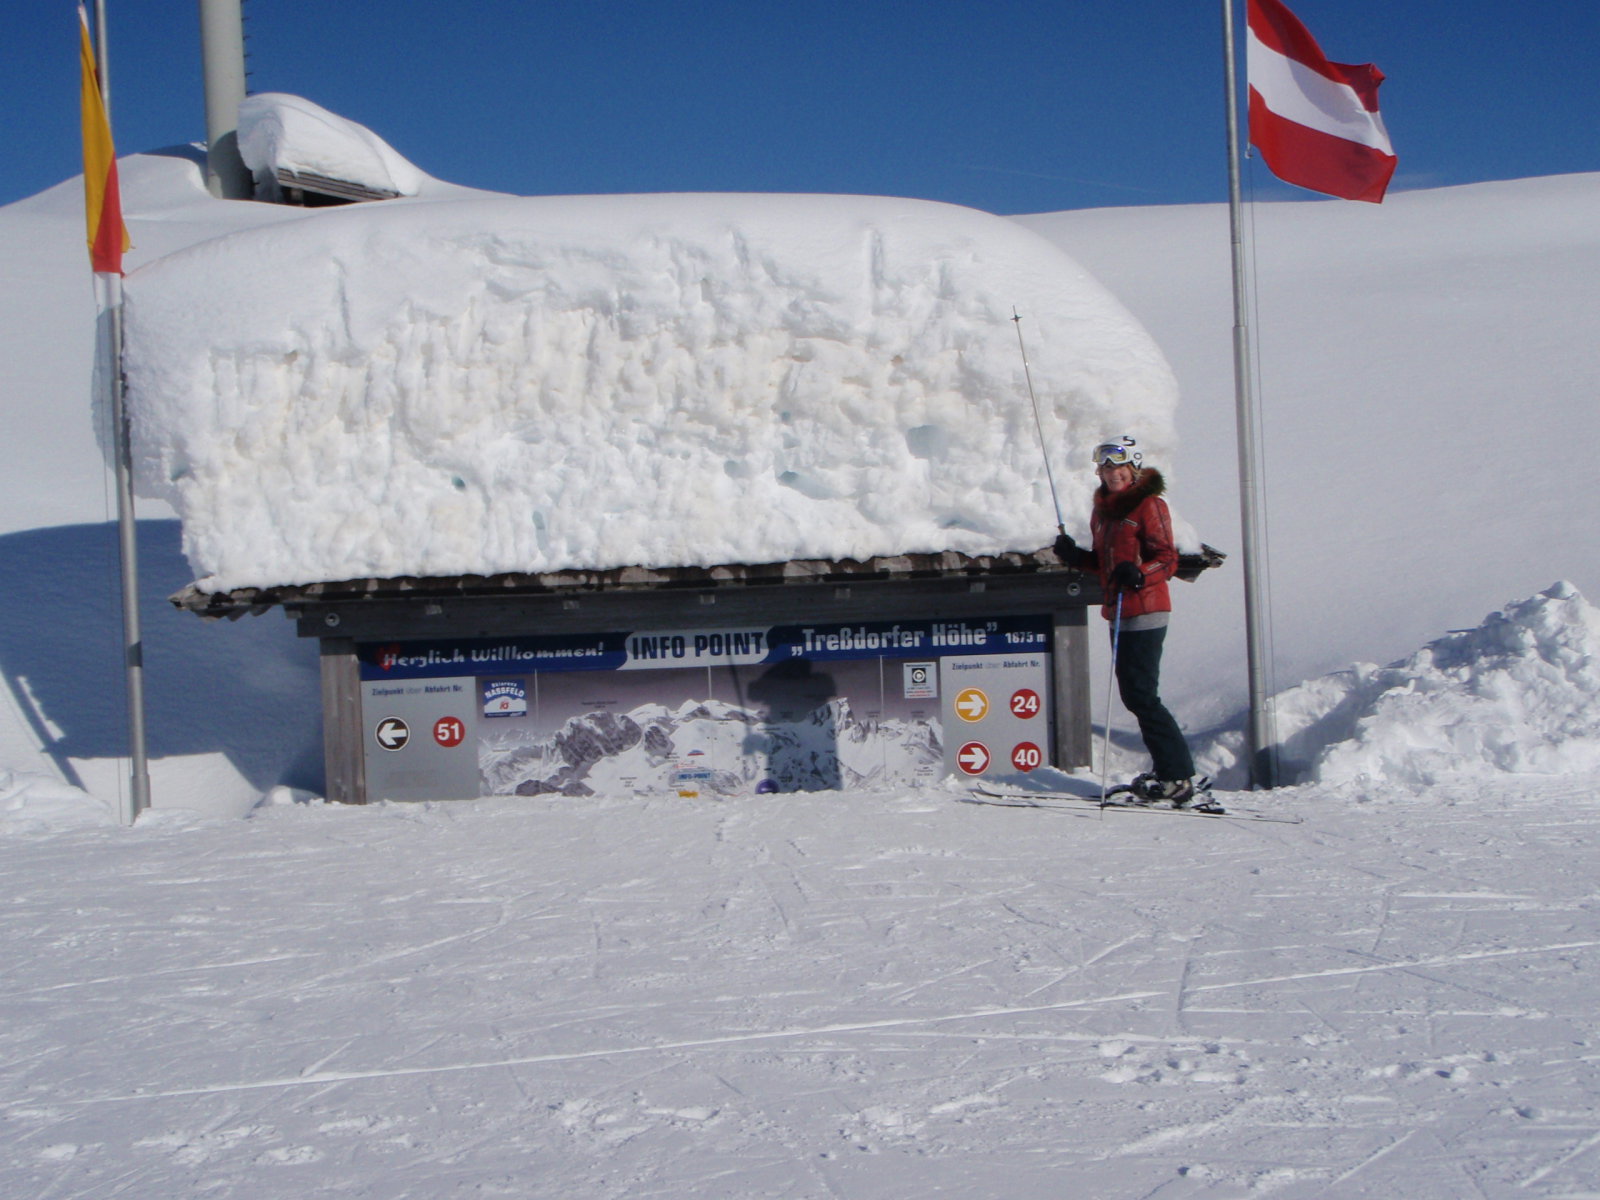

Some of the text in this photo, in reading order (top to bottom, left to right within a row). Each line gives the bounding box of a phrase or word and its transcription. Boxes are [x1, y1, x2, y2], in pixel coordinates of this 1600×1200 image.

[632, 631, 764, 660] INFO POINT
[791, 625, 925, 657] „Treßdorfer
[1005, 632, 1034, 644] 1875
[1036, 634, 1046, 643] m
[384, 642, 604, 667] Herzlich Willkommen!
[951, 662, 983, 672] Zielpunkt
[1003, 660, 1028, 668] Abfahrt
[371, 686, 404, 697] Zielpunkt
[424, 684, 451, 694] Abfahrt
[485, 687, 525, 699] NASSFELD
[1013, 695, 1038, 713] 24
[436, 723, 460, 741] 51
[1013, 749, 1039, 766] 40
